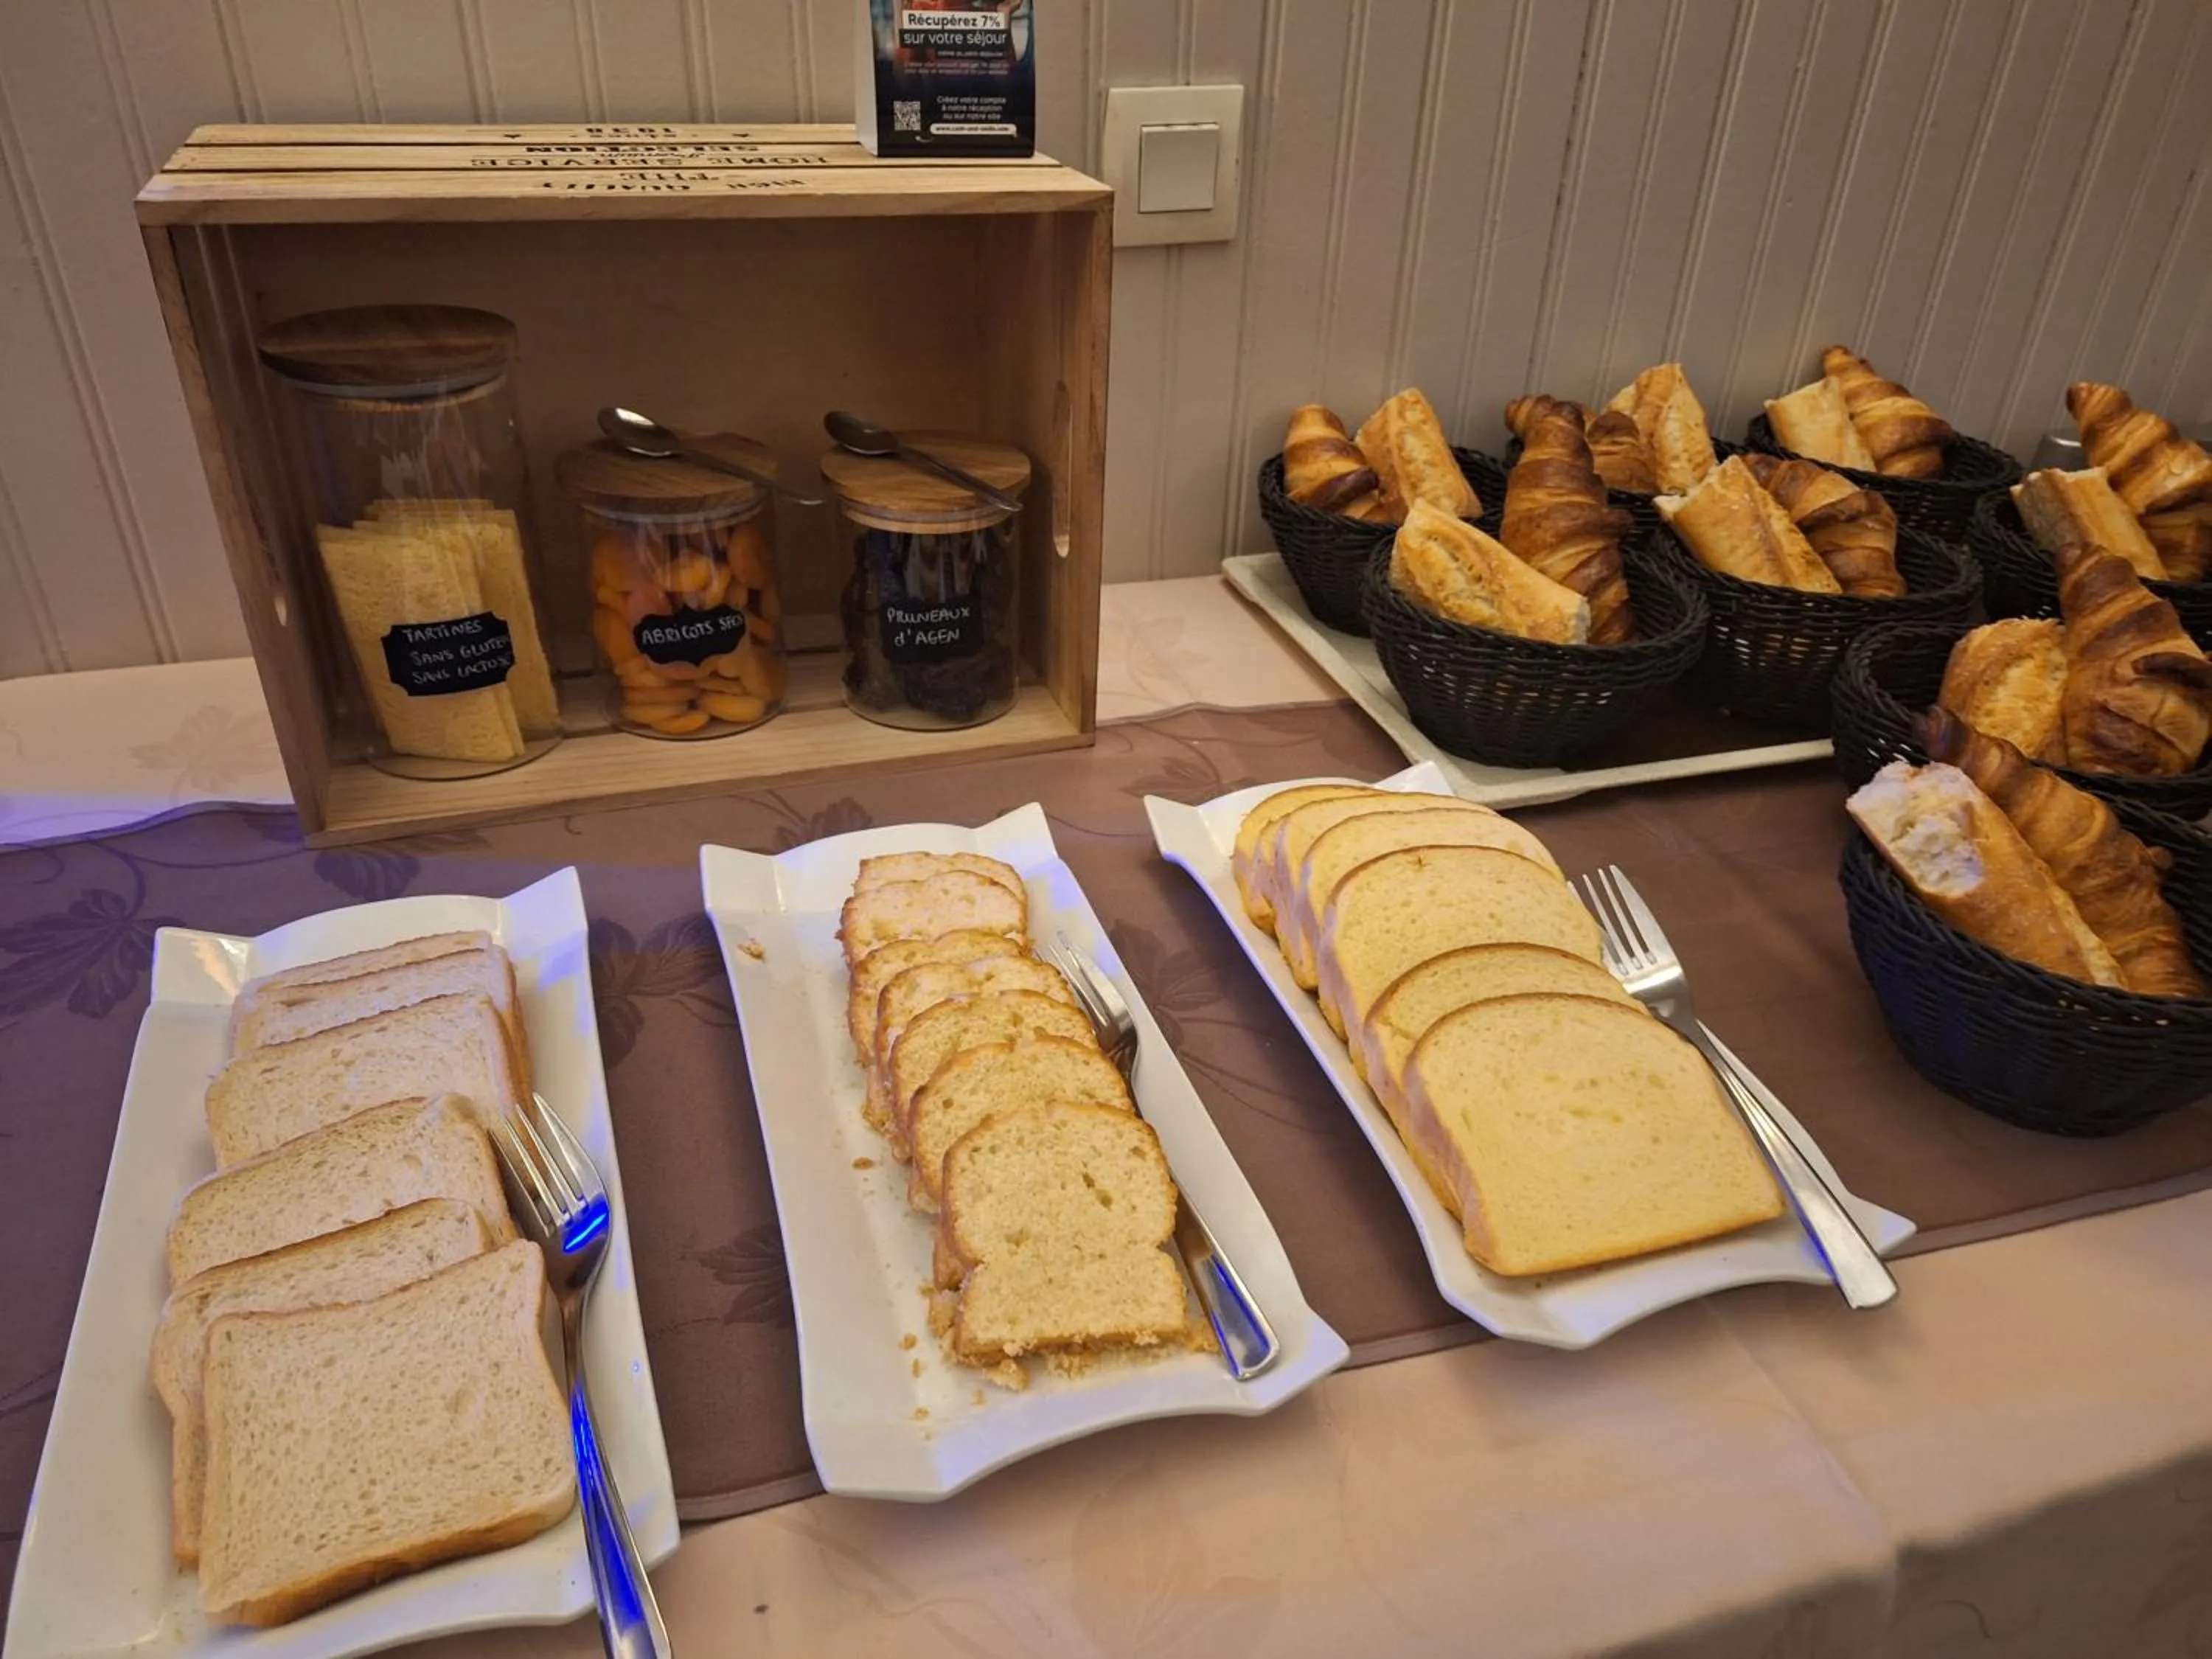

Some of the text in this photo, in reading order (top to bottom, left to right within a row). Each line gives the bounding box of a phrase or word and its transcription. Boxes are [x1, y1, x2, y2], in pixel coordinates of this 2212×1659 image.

[908, 13, 1001, 29] Récupérez 7%
[903, 30, 1006, 46] sur votre séjour
[471, 158, 682, 166] SERVICE
[887, 607, 970, 623] PRUNEAUX
[894, 627, 959, 646] d'AGEN
[410, 650, 453, 666] SANS
